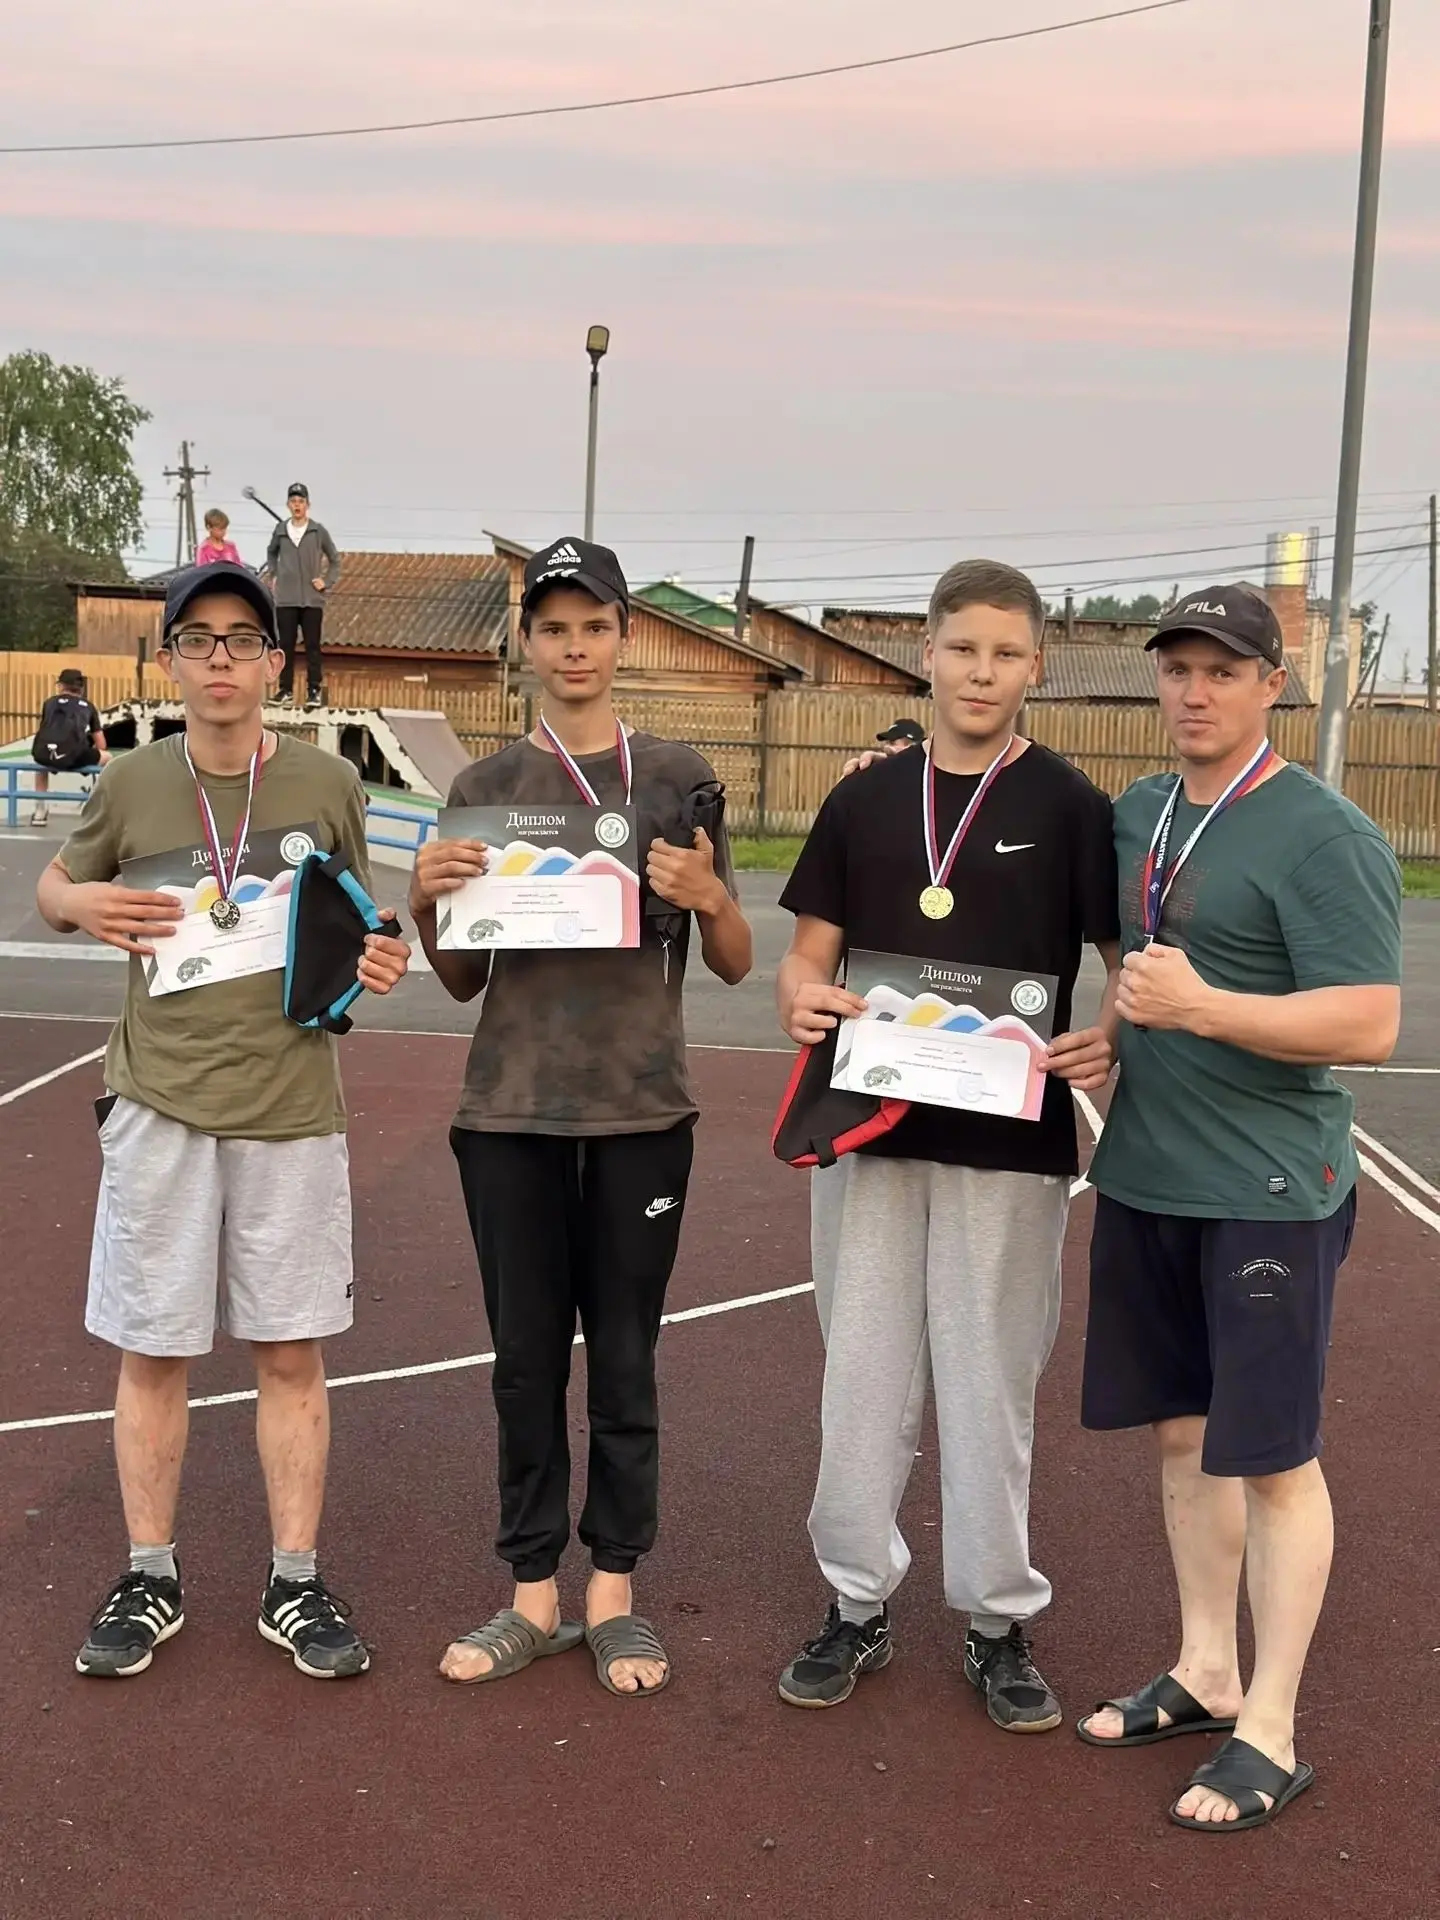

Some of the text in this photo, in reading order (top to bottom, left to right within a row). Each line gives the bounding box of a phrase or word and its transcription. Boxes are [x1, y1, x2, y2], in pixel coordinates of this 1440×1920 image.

[547, 556, 581, 565] adidas
[1184, 601, 1226, 616] FILA
[506, 812, 565, 828] Диплом
[1156, 817, 1173, 869] FEDERATION
[919, 964, 982, 985] Диплом
